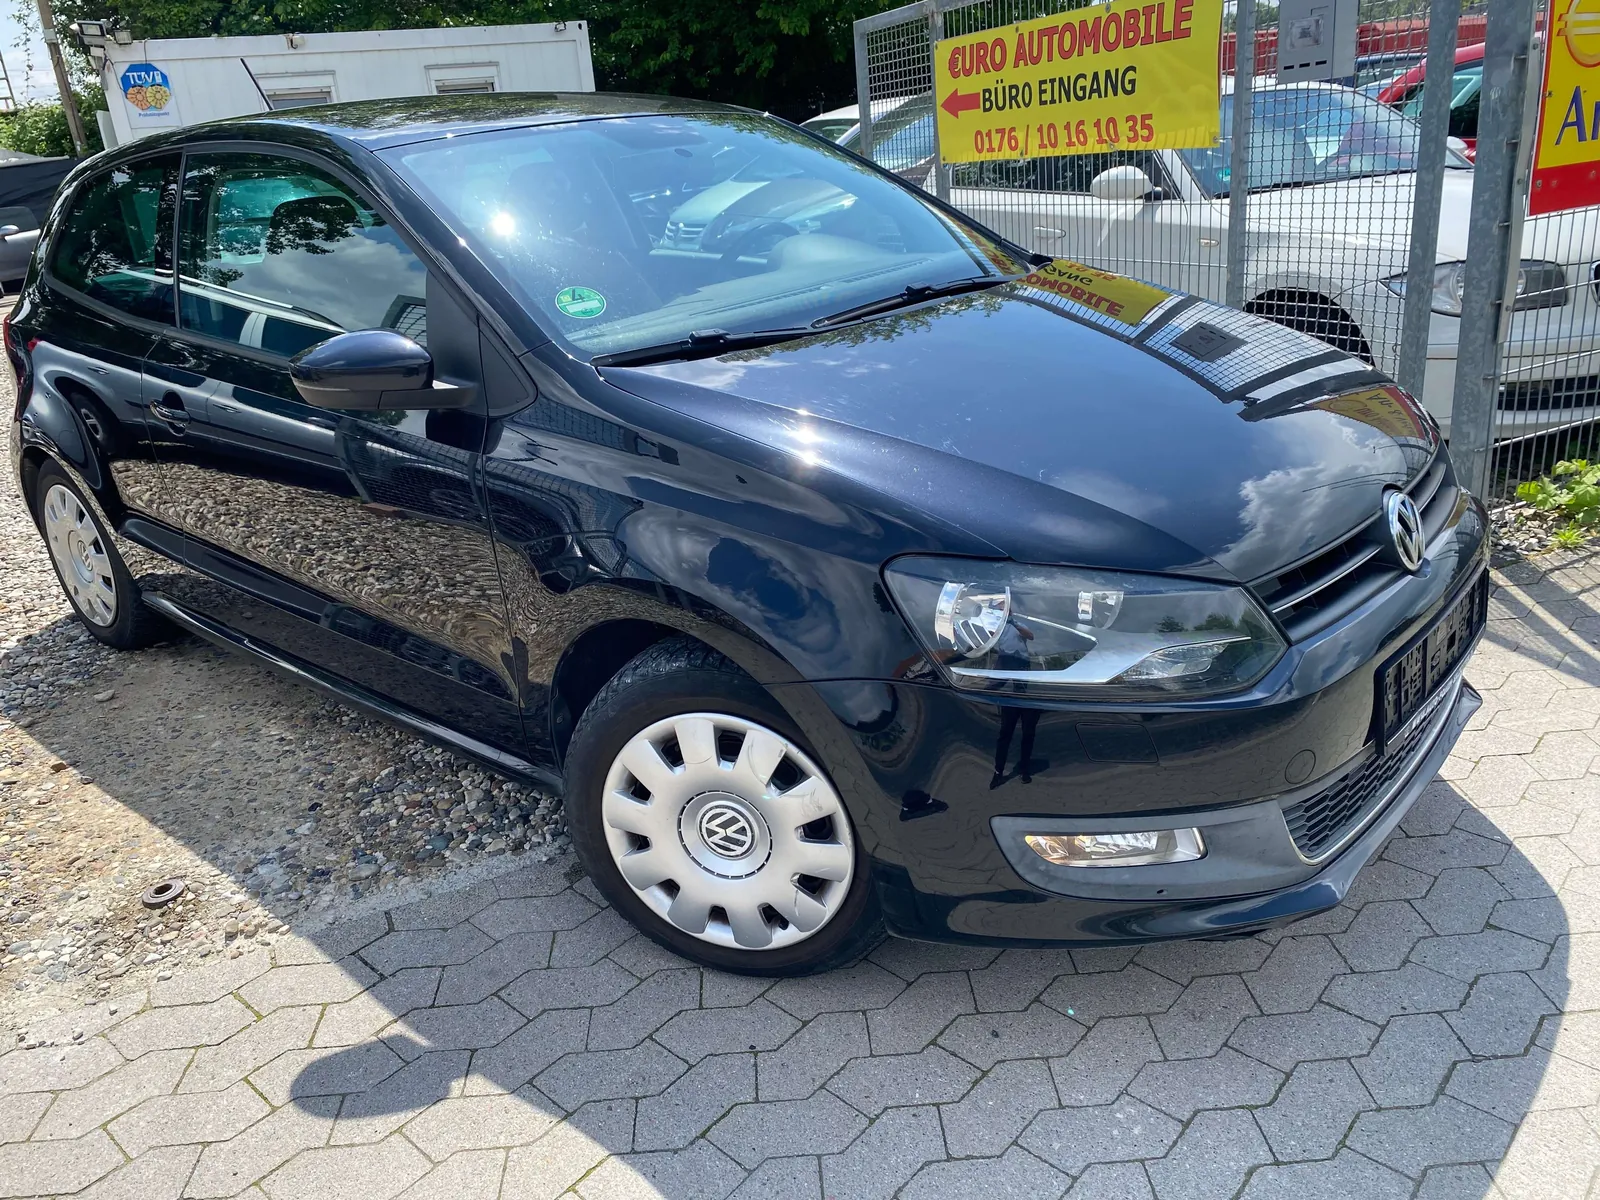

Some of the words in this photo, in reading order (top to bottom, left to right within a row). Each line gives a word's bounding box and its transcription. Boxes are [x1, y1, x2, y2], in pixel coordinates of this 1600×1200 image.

[948, 37, 1007, 79] €URO
[1013, 0, 1194, 69] AUTOMOBILE
[982, 79, 1032, 113] BÜRO
[1039, 65, 1137, 106] EINGANG
[974, 126, 1019, 155] 0176
[1037, 122, 1058, 149] 10
[1064, 120, 1088, 148] 16
[1093, 117, 1119, 144] 10
[1126, 114, 1154, 143] 35
